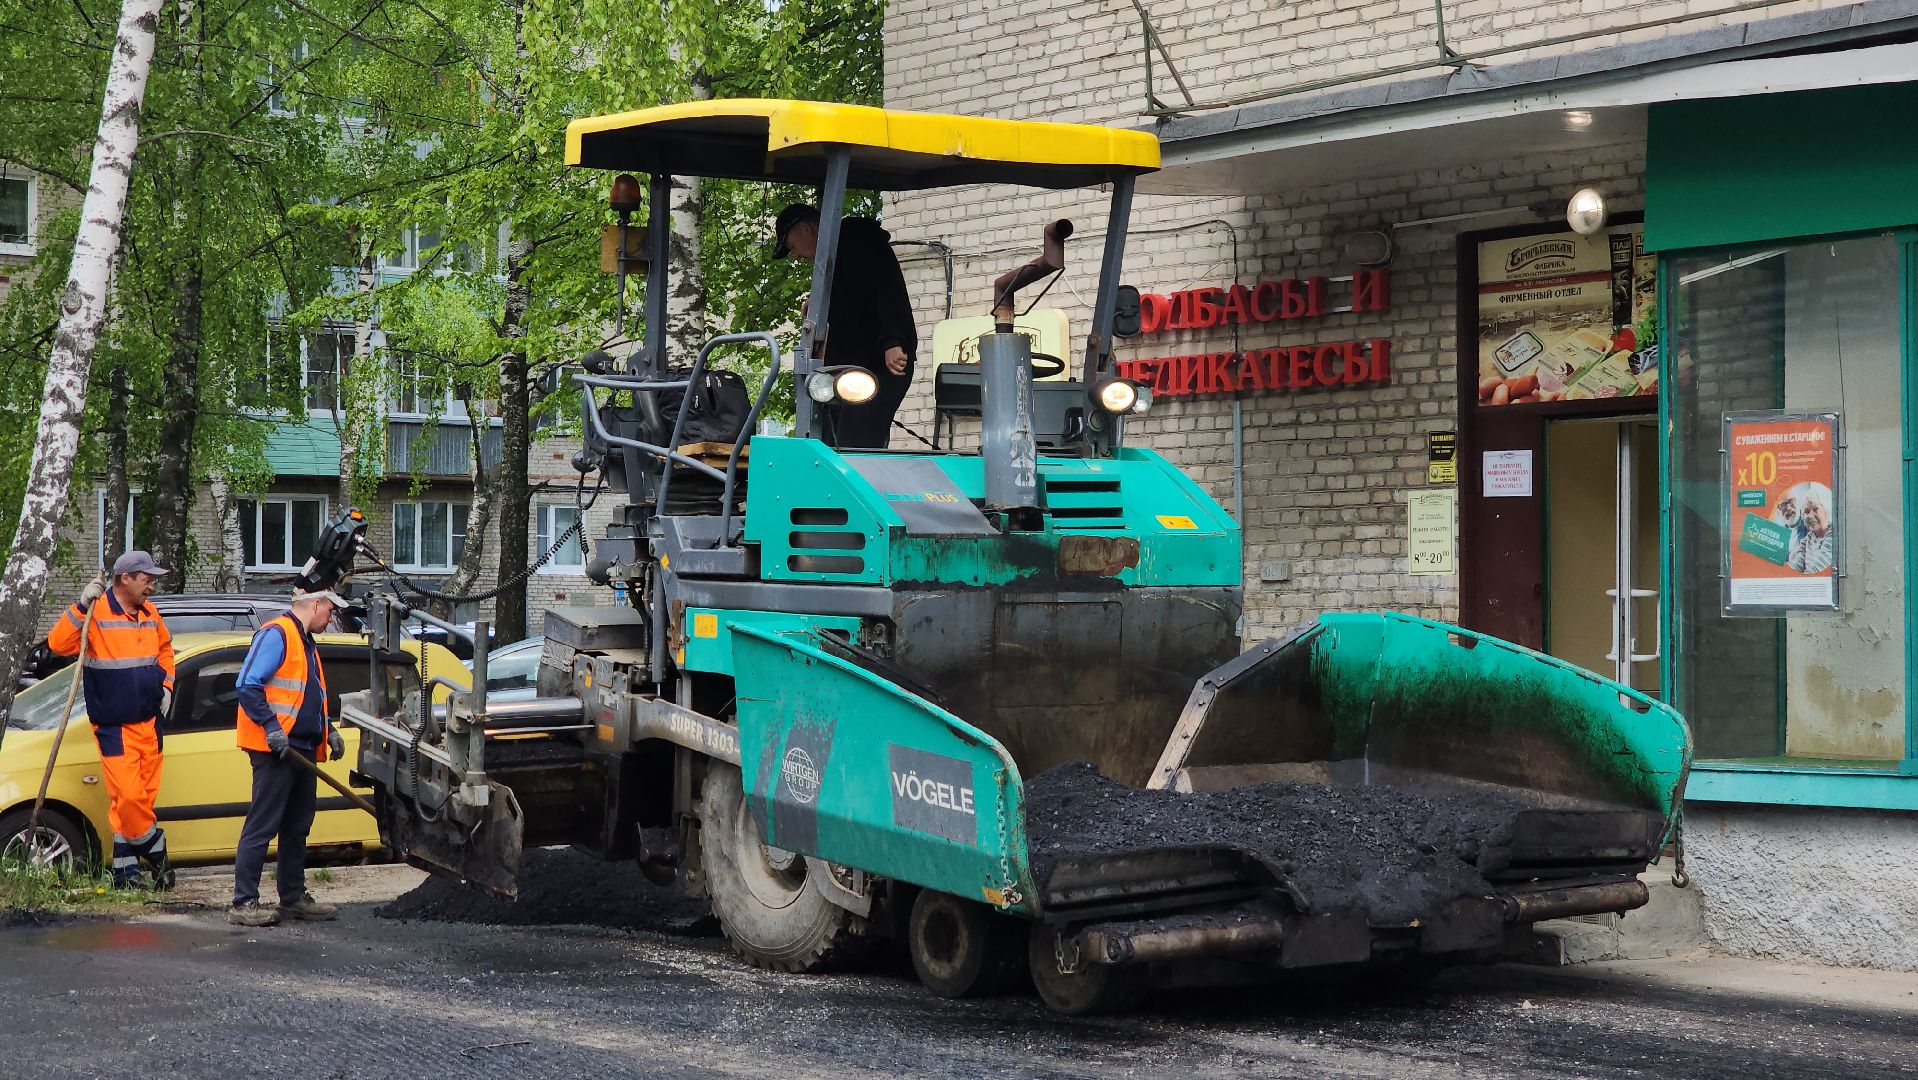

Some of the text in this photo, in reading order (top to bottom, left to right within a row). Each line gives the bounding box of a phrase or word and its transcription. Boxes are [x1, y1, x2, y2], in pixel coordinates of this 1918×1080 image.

[1534, 261, 1566, 271] ФАБРИКА
[1139, 269, 1390, 334] ОЛБАСЫ И
[1498, 286, 1582, 304] ФИРМЕННЫЙ ОТДЕЛ
[1741, 433, 1783, 445] УВАЖЕНИЕМ
[1789, 431, 1825, 443] СТАРШИМ!
[670, 712, 704, 743] SUPER
[782, 758, 820, 783] WIRTGEN
[784, 773, 817, 791] GROUP
[892, 769, 976, 815] VÖGELE
